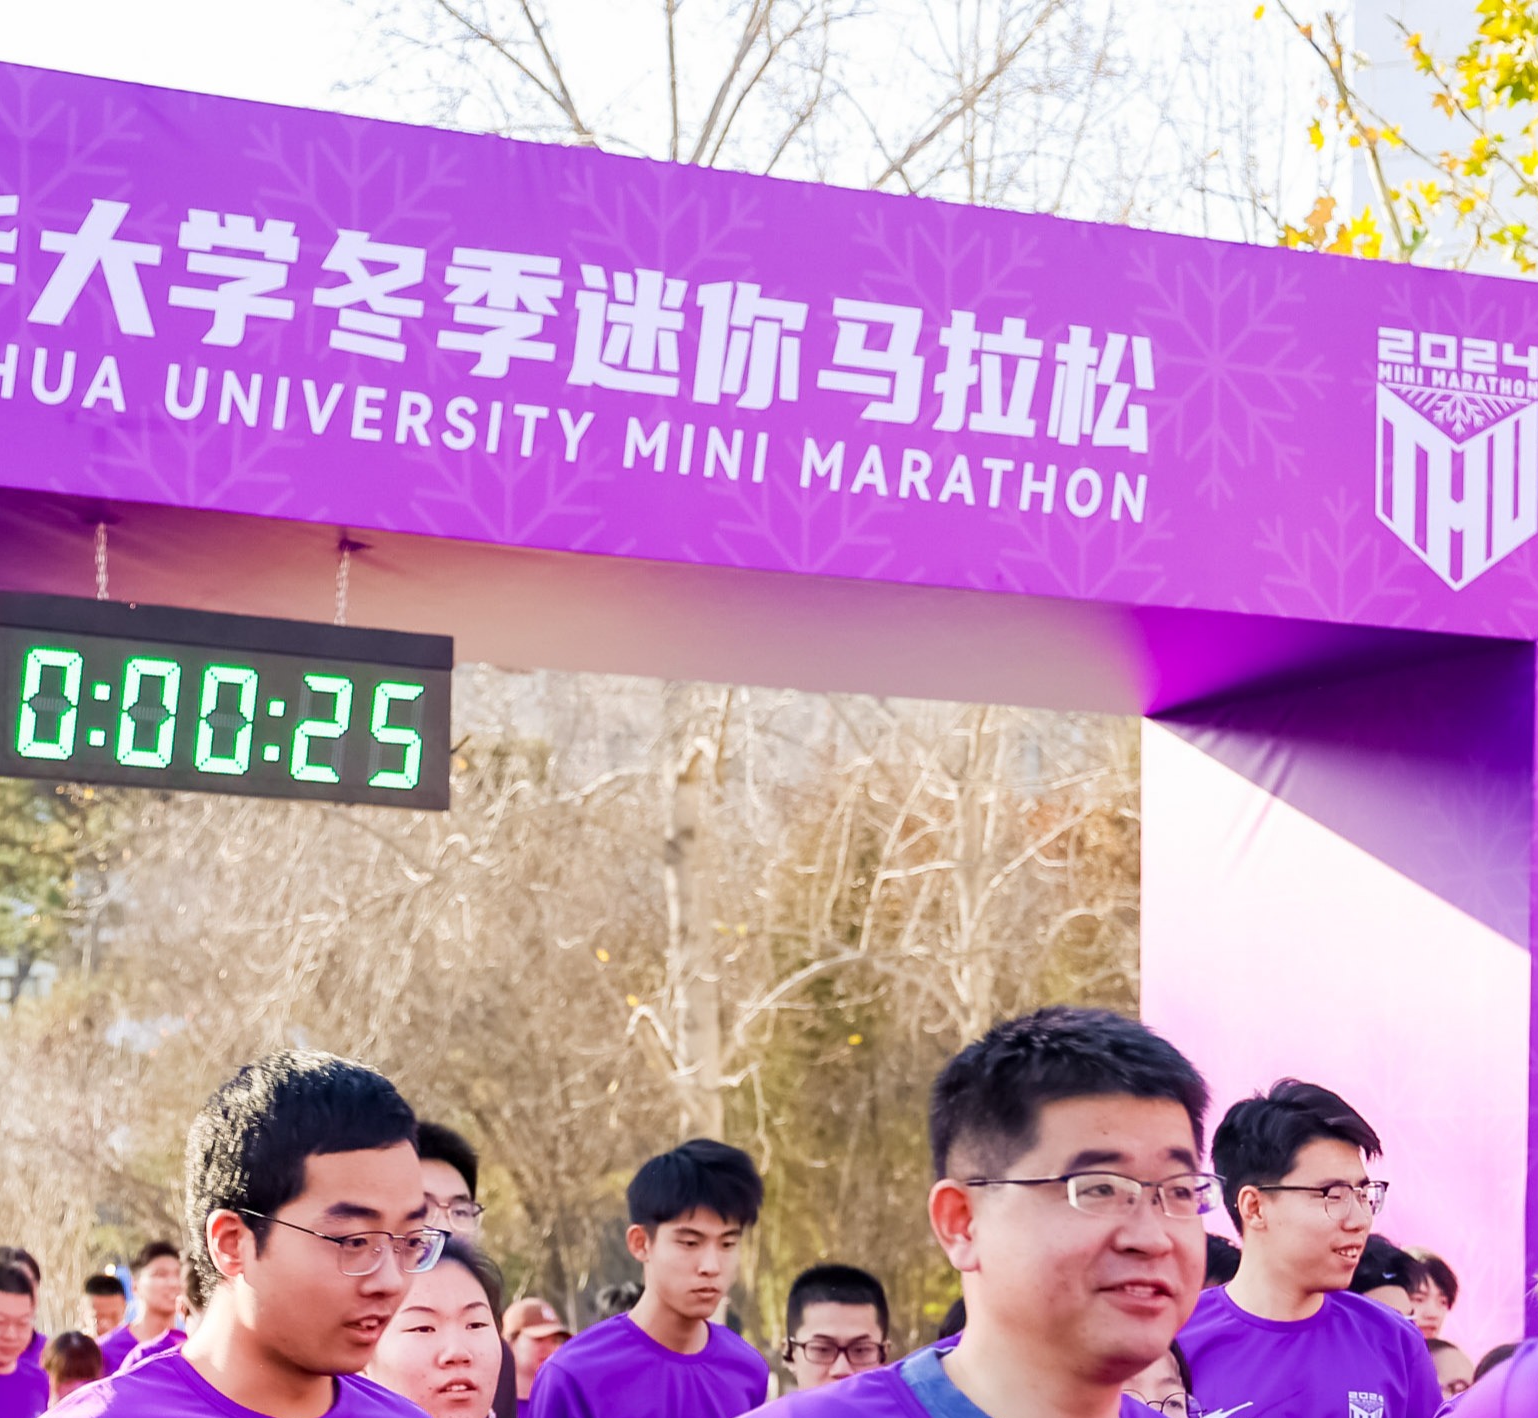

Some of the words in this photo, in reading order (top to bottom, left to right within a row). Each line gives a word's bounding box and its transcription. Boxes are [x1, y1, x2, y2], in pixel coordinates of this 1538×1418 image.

[165, 363, 594, 463] UNIVERSITY
[622, 416, 768, 483] MINI
[799, 437, 1149, 524] MARATHON
[1377, 362, 1424, 385] MINI
[1431, 369, 1538, 398] MARATHON
[15, 646, 425, 791] 0:00:25
